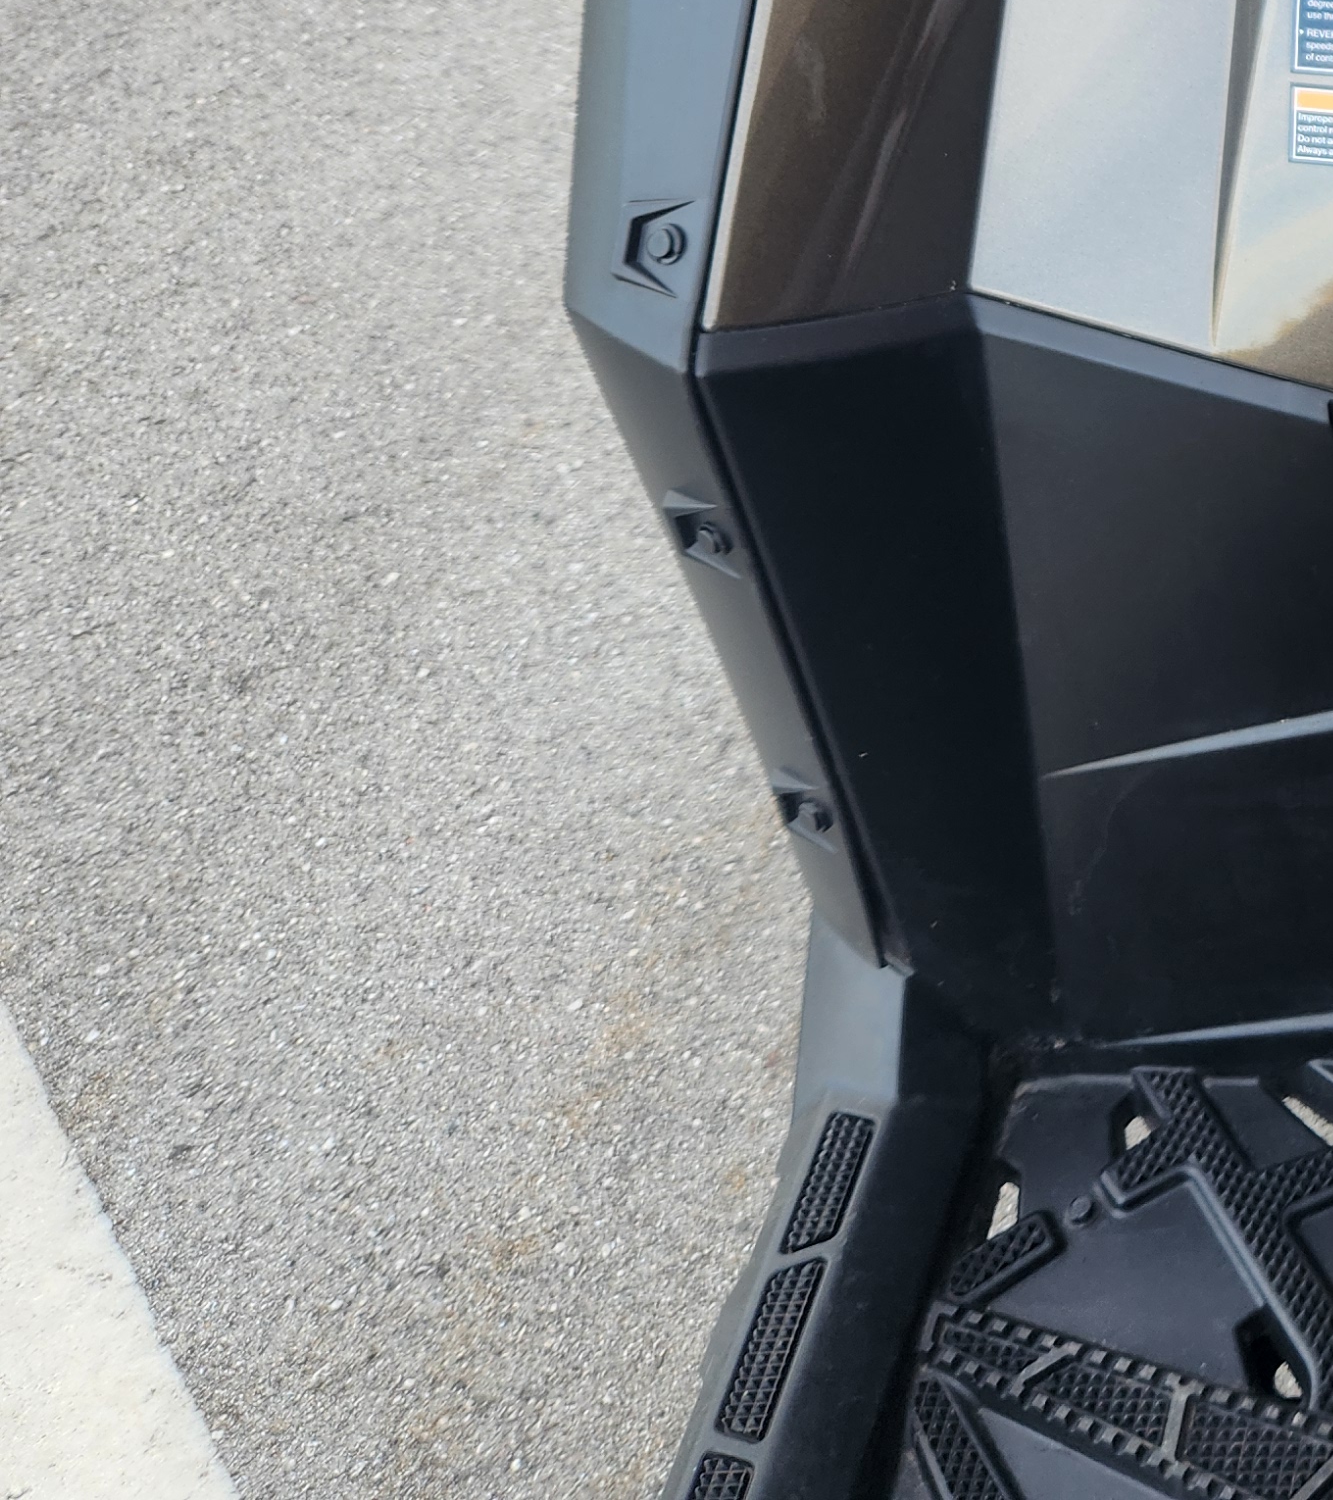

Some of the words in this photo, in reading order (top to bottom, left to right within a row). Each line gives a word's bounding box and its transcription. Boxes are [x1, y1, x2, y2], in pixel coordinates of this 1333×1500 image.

[1307, 11, 1322, 19] use
[1298, 124, 1327, 134] control
[1311, 135, 1326, 144] not
[1297, 145, 1327, 156] Always
